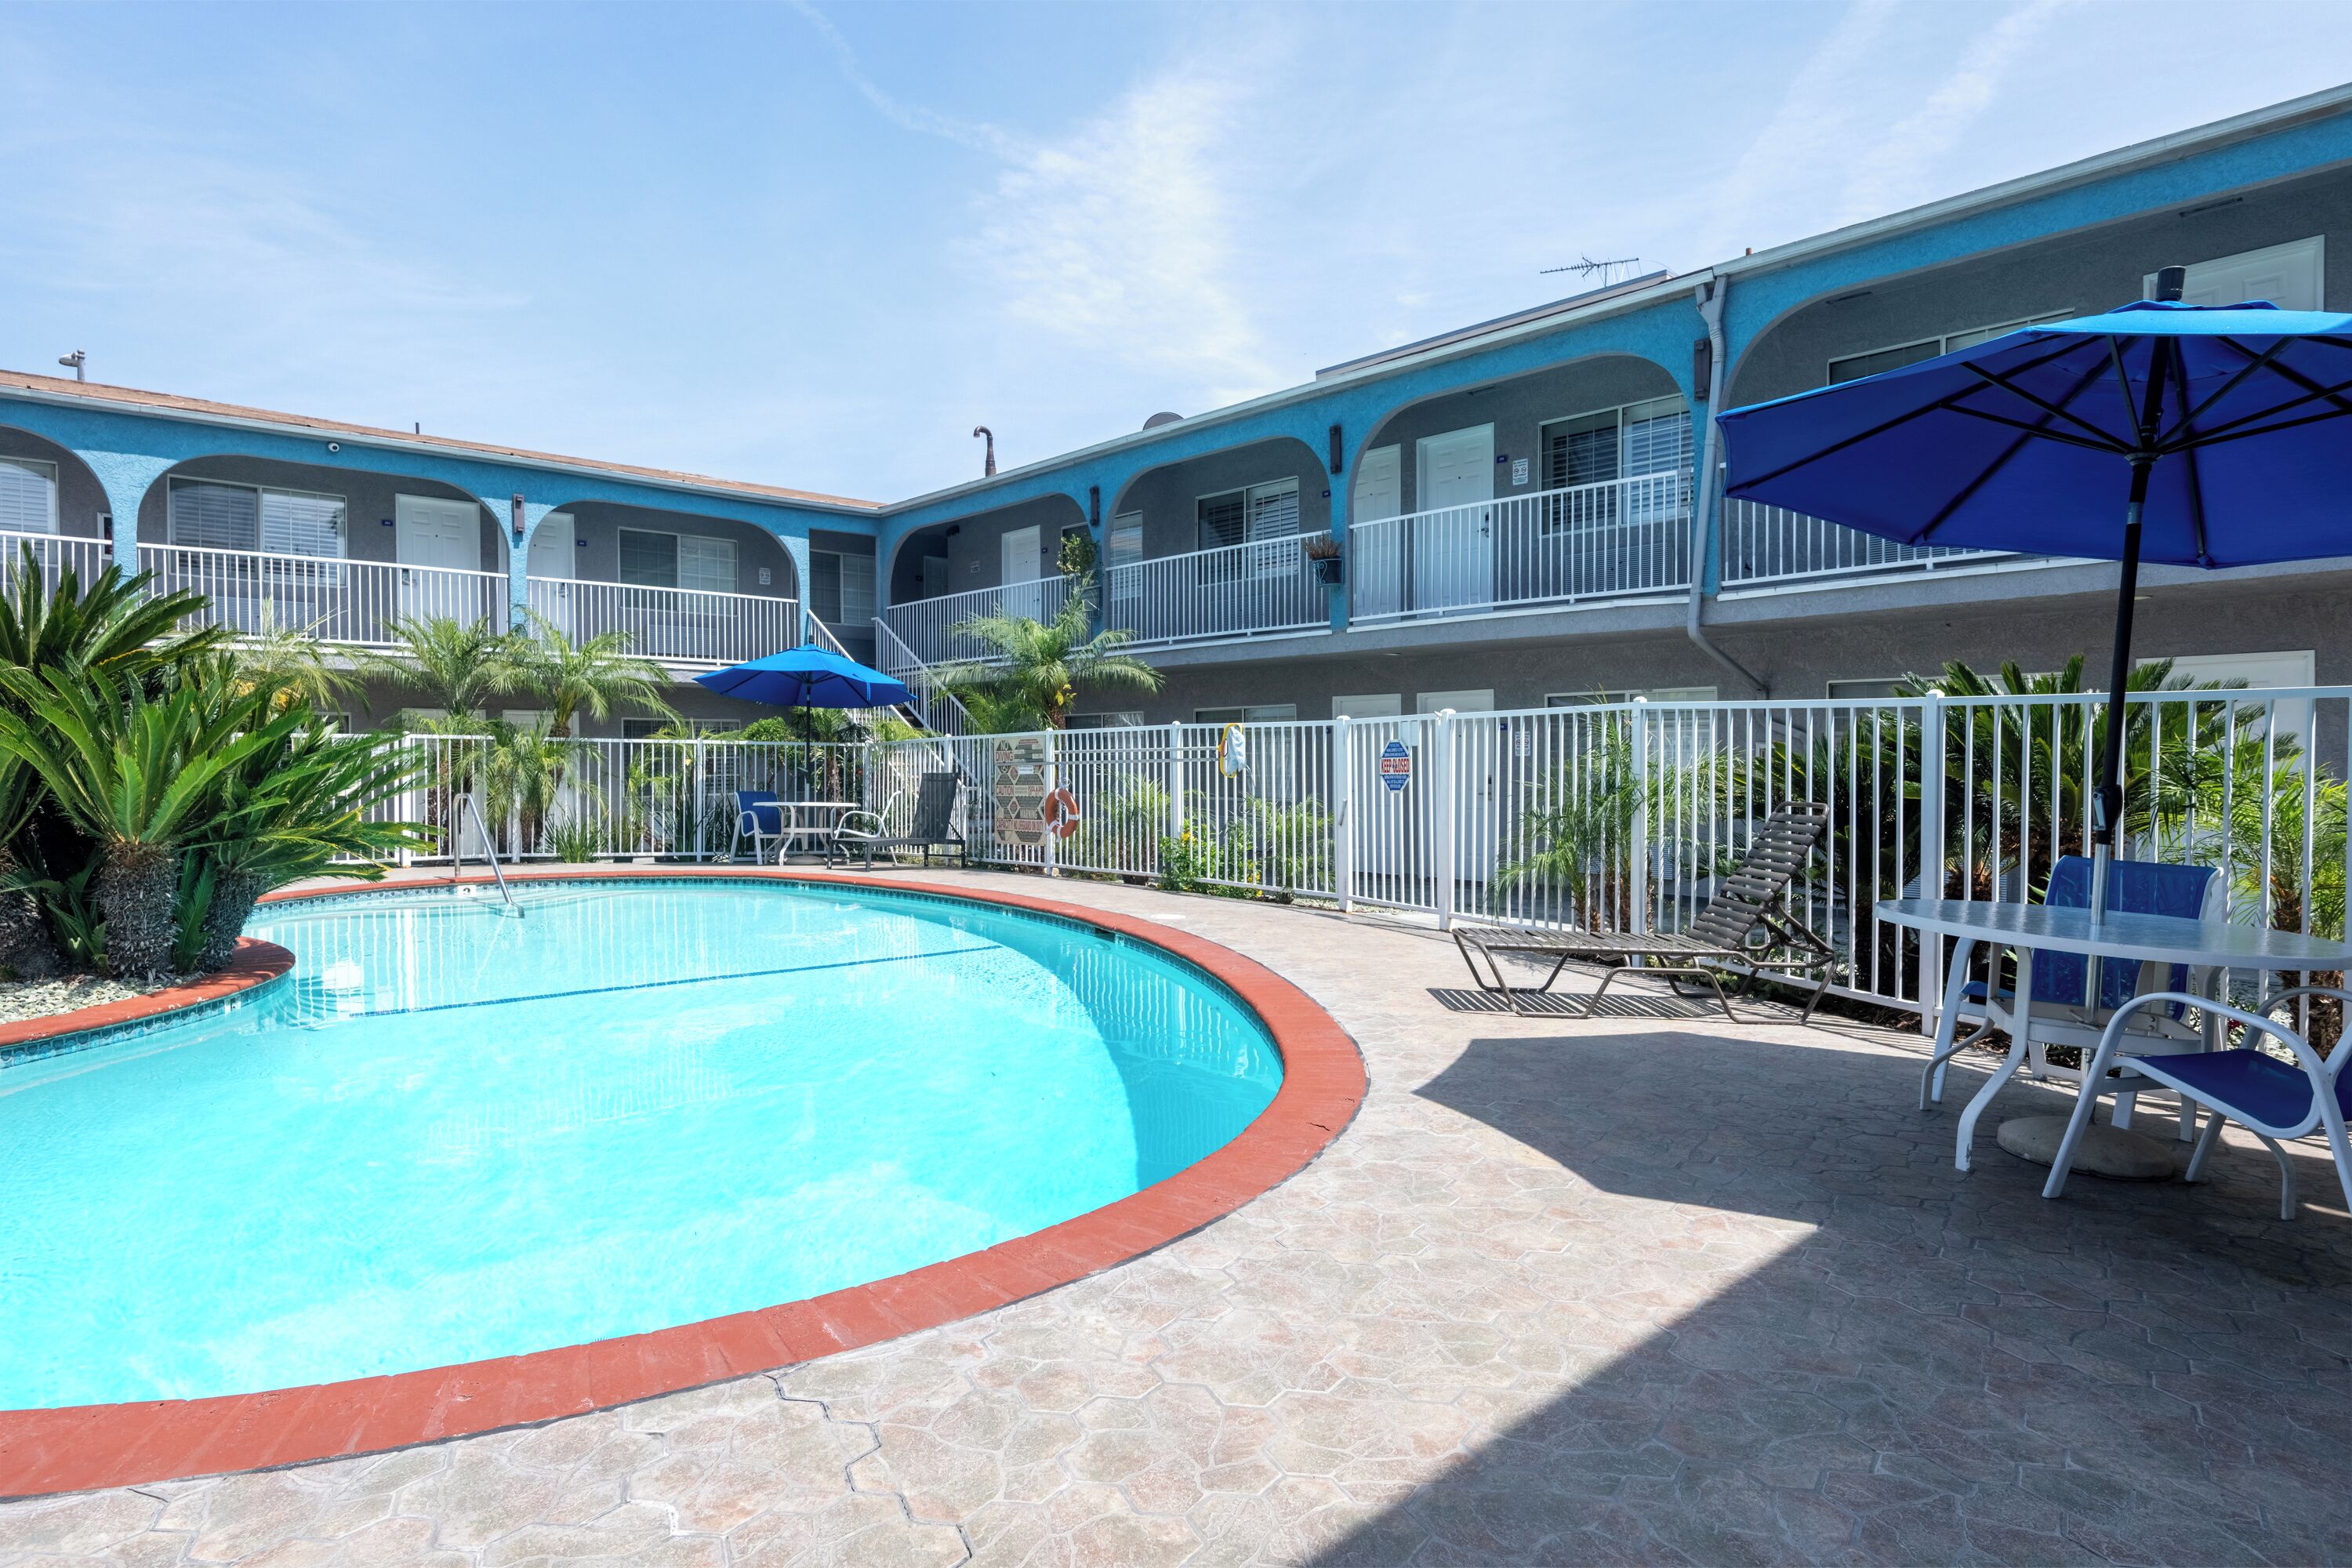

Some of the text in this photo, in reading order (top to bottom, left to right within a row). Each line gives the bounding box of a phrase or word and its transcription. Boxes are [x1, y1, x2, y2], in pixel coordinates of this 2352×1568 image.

[1000, 740, 1009, 750] NO
[996, 752, 1014, 761] DIVING
[1381, 758, 1410, 773] KEEP CLOSED
[996, 786, 1014, 796] CAUTION
[1019, 808, 1037, 819] WARNING
[996, 818, 1013, 829] CAPACITY
[1014, 820, 1018, 830] NO
[1018, 820, 1032, 831] LIFEGUARD
